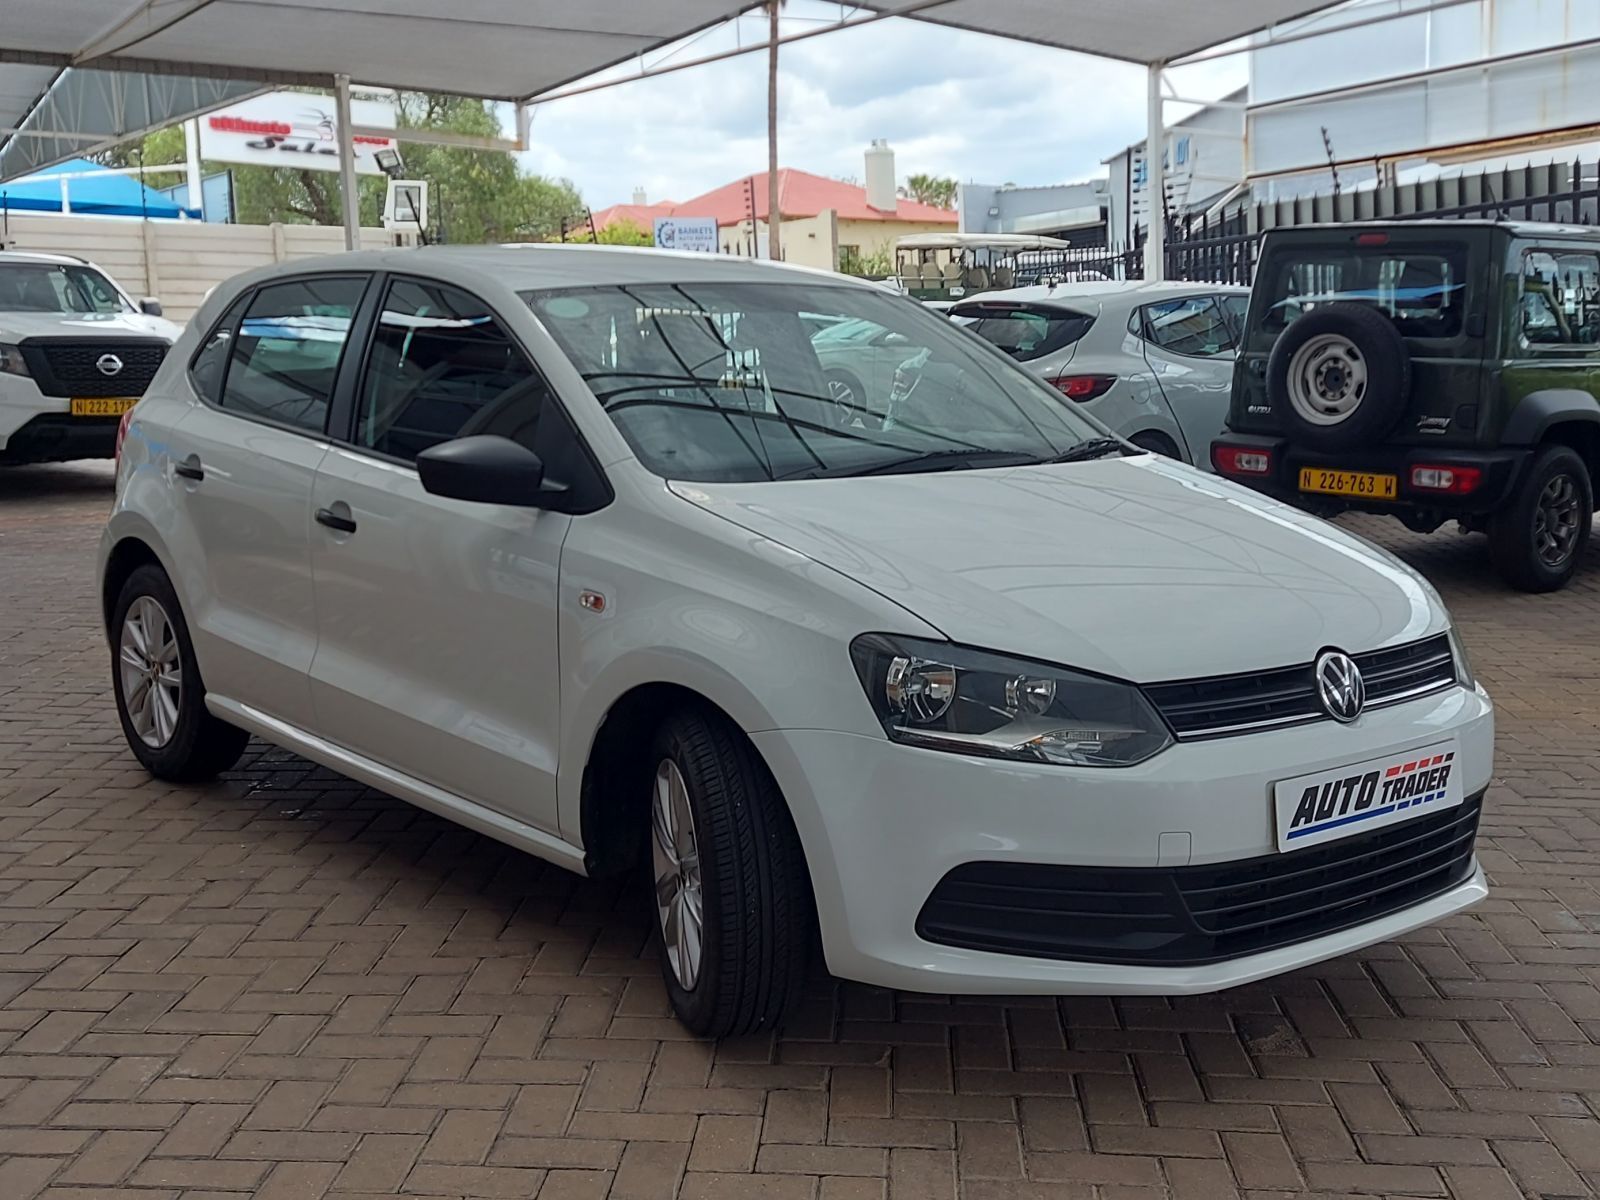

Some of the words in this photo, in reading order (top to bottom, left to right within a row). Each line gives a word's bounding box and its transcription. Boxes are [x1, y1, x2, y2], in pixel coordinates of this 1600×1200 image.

[209, 115, 291, 135] ultimate
[246, 136, 361, 158] Sale
[76, 401, 83, 414] N
[88, 401, 109, 414] 222
[1303, 470, 1312, 488] N
[1320, 472, 1375, 494] 226-763
[1385, 477, 1393, 495] W
[1289, 770, 1381, 829] AUTO
[1380, 764, 1452, 805] TRADER
